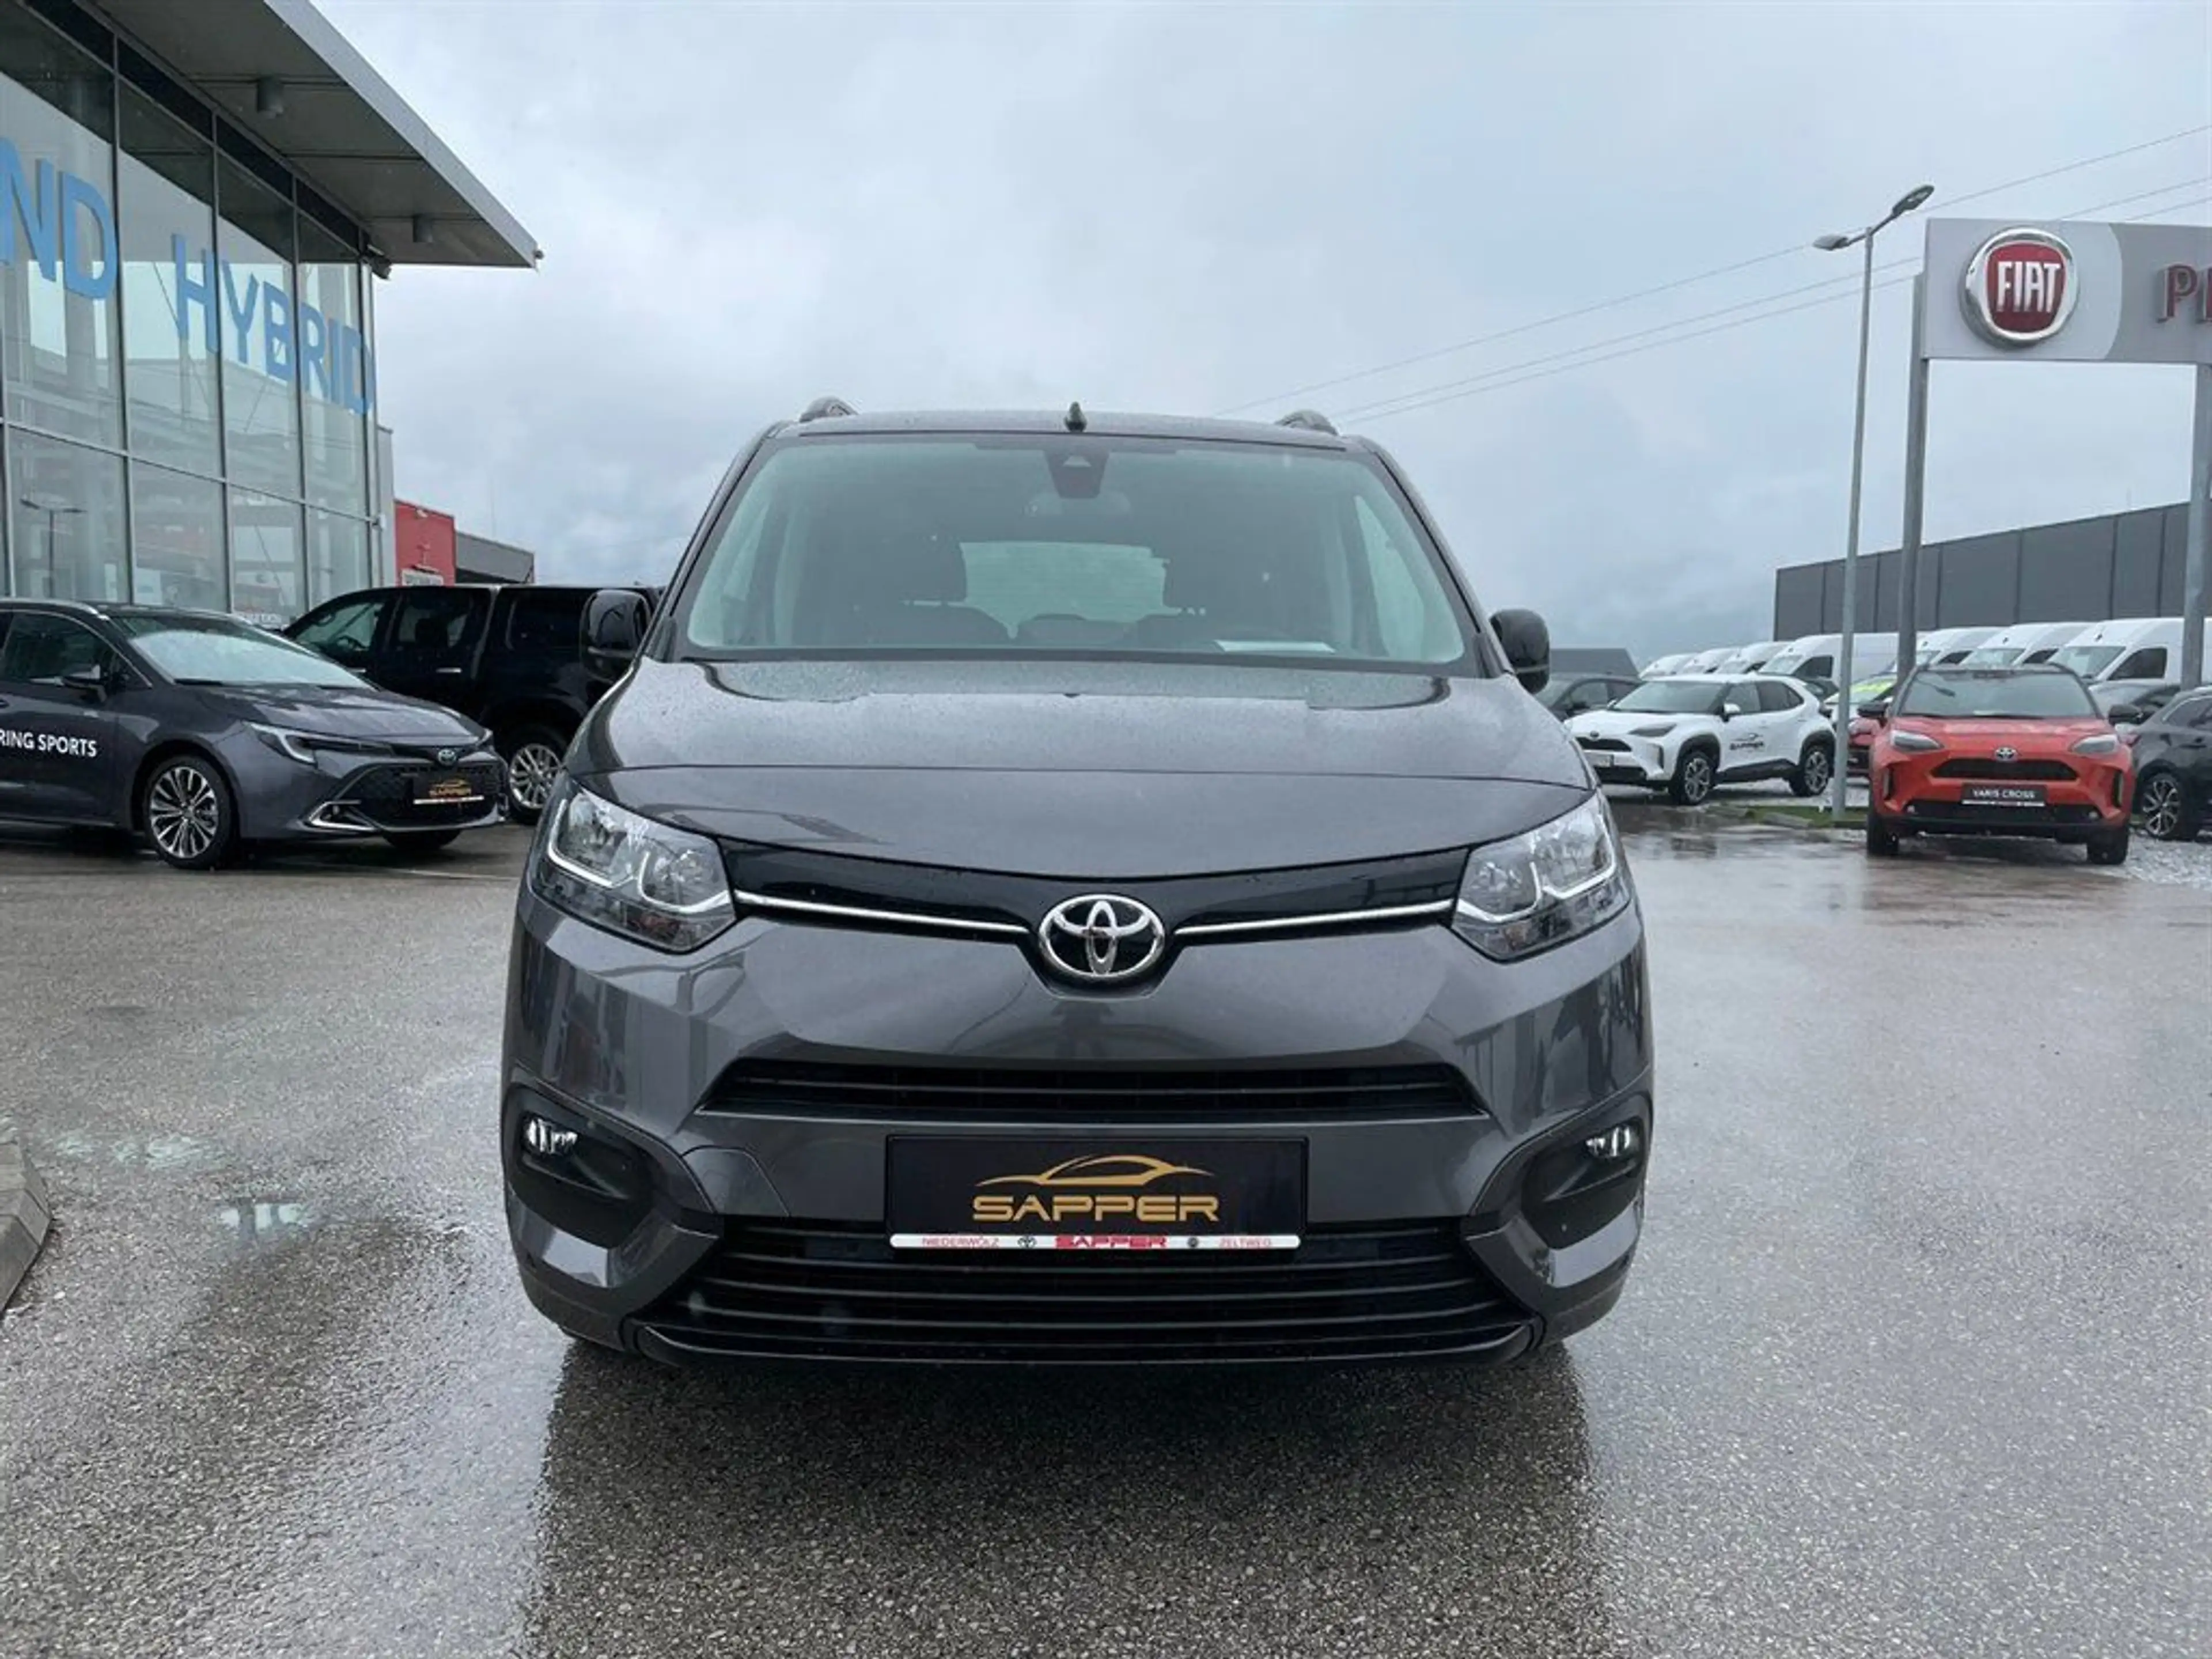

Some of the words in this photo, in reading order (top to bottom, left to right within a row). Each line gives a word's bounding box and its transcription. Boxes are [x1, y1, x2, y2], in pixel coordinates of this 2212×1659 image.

[1997, 262, 2061, 313] FIAT
[171, 233, 377, 416] HYBRID
[37, 734, 97, 757] SPORTS
[1972, 789, 1999, 798] YARIS
[2002, 789, 2036, 799] CROSS
[972, 1195, 1220, 1222] SAPPER
[1056, 1234, 1168, 1249] SAPPER
